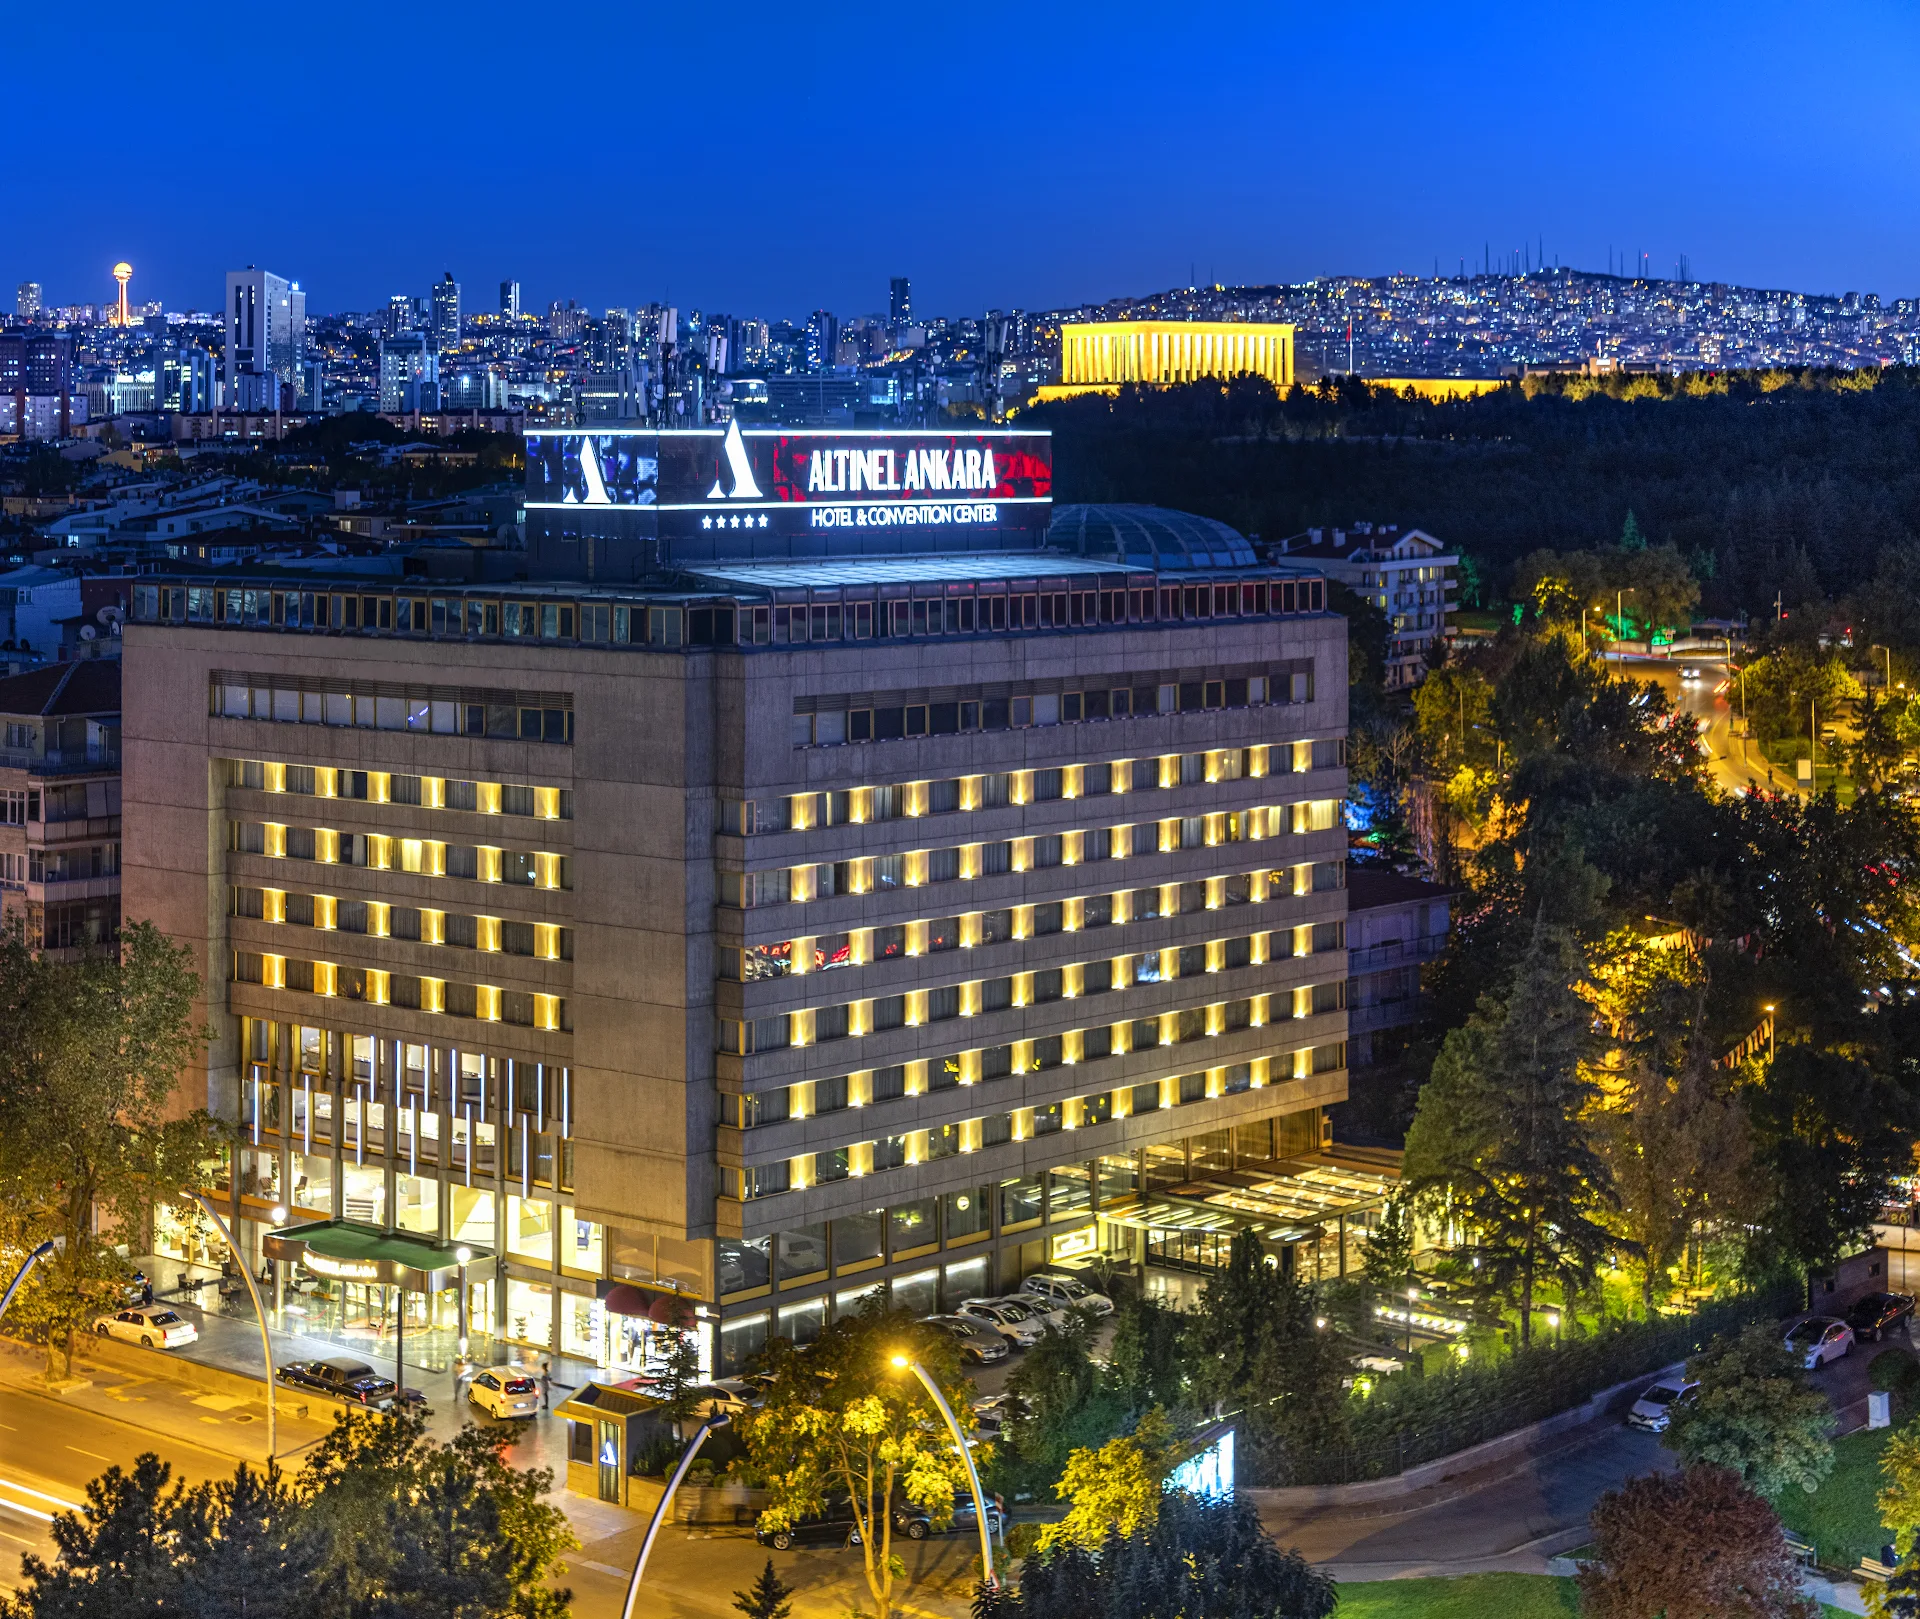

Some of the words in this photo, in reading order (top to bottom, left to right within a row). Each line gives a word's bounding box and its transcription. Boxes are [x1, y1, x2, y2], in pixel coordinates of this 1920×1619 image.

[808, 449, 900, 491] ALTINEL
[903, 449, 996, 490] ANKARA
[812, 507, 854, 527] HOTEL
[856, 509, 867, 526] &
[868, 505, 951, 526] CONVENTION
[953, 504, 997, 524] CENTER
